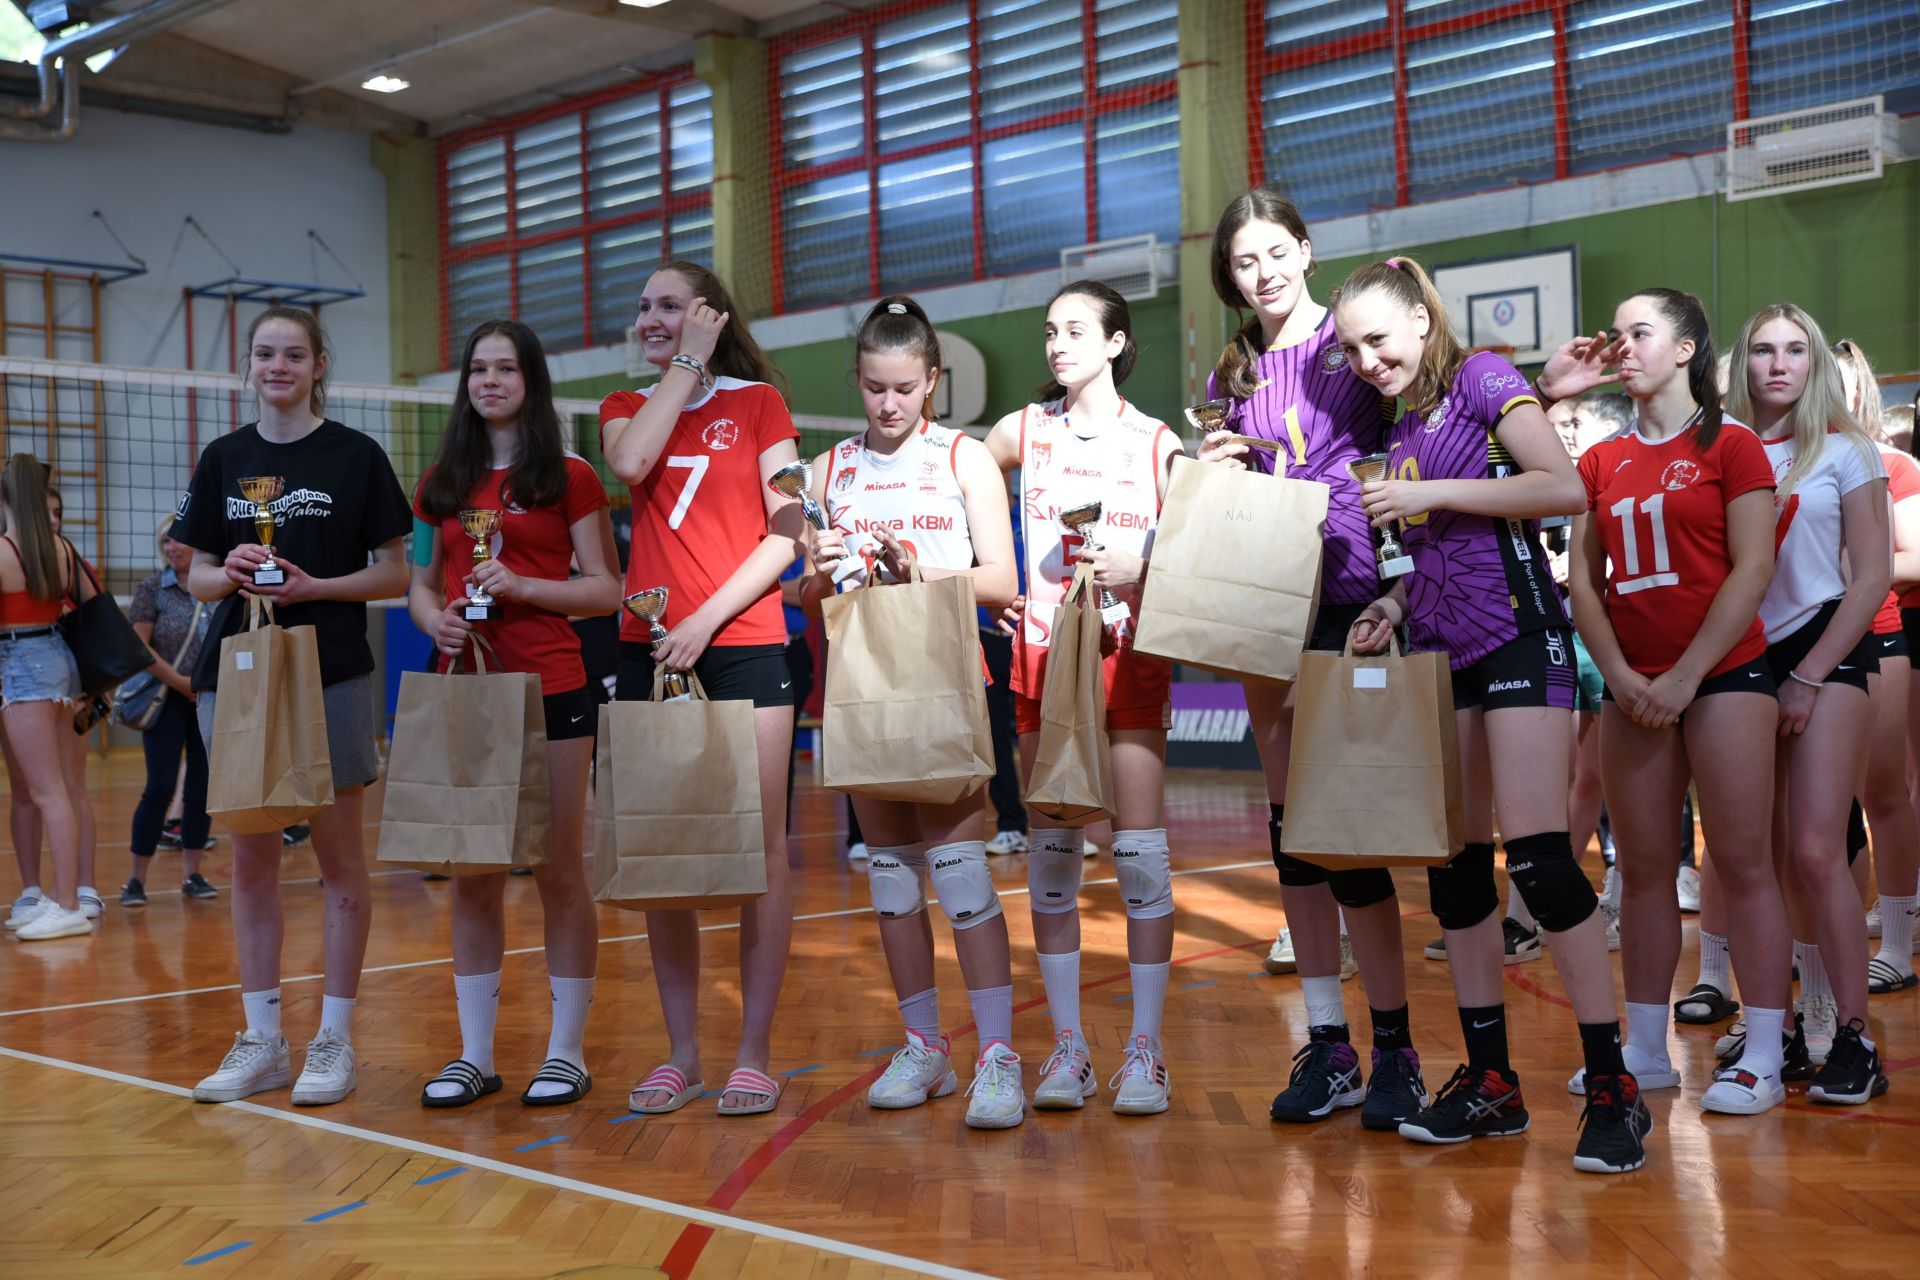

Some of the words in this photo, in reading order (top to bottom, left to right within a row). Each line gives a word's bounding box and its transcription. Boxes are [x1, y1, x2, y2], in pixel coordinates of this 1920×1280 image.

[667, 455, 710, 530] 7
[287, 502, 331, 519] Tabor
[1225, 508, 1252, 522] NAJ
[855, 518, 904, 533] Nova
[912, 515, 953, 531] KBM
[1106, 511, 1149, 531] KBM
[1510, 521, 1528, 558] KOPER
[1610, 493, 1670, 576] 11
[1524, 562, 1535, 580] Port
[1529, 581, 1538, 590] of
[1533, 590, 1546, 615] Koper
